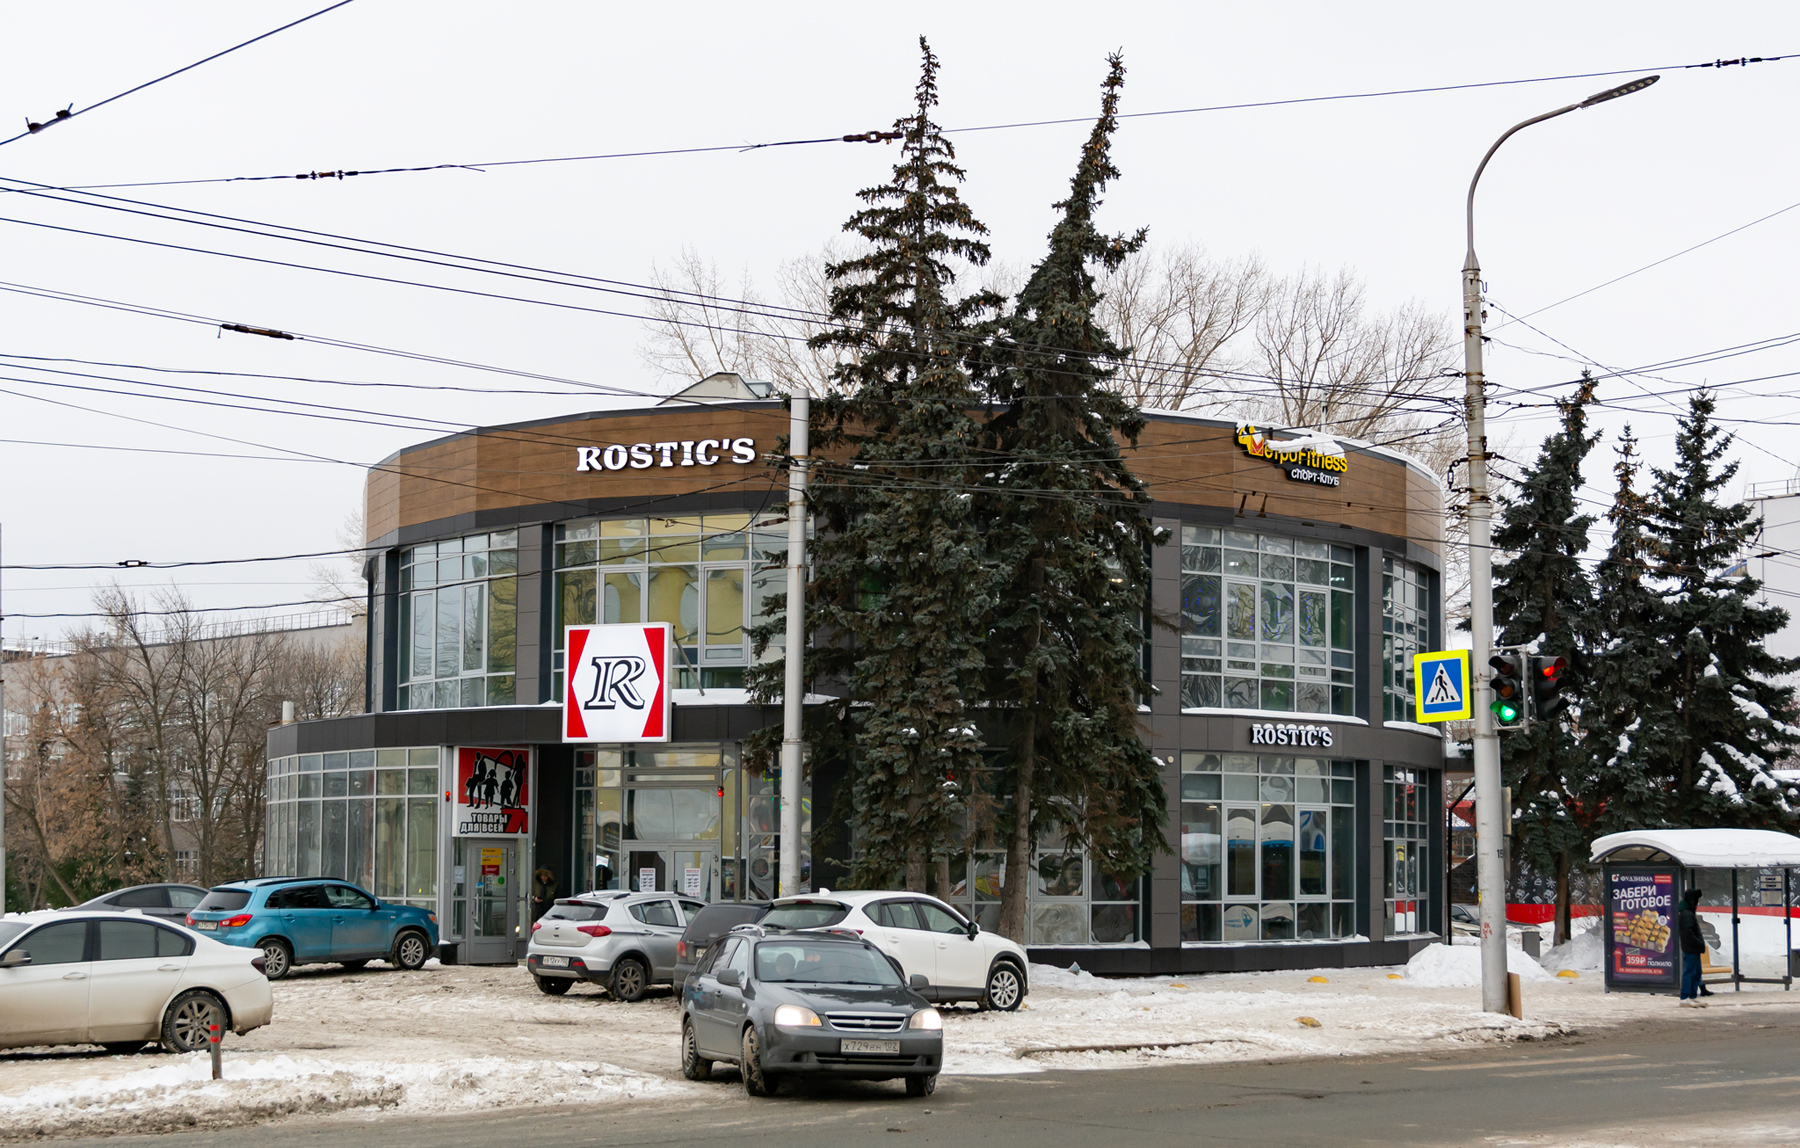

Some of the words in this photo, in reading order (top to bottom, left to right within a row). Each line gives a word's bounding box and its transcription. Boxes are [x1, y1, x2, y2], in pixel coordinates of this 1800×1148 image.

[576, 437, 757, 472] ROSTIC'S
[1291, 468, 1340, 486] СПОРТ-КЛУБ
[583, 655, 647, 711] R
[1252, 726, 1333, 747] ROSTIC'S
[471, 813, 508, 824] ТОВАРЫ
[460, 823, 479, 834] ДЛЯ
[482, 823, 504, 833] ВСЕЙ
[1613, 885, 1657, 900] ЗАБЕРИ
[1620, 895, 1671, 910] ГОТОВОЕ
[884, 1041, 897, 1049] 102
